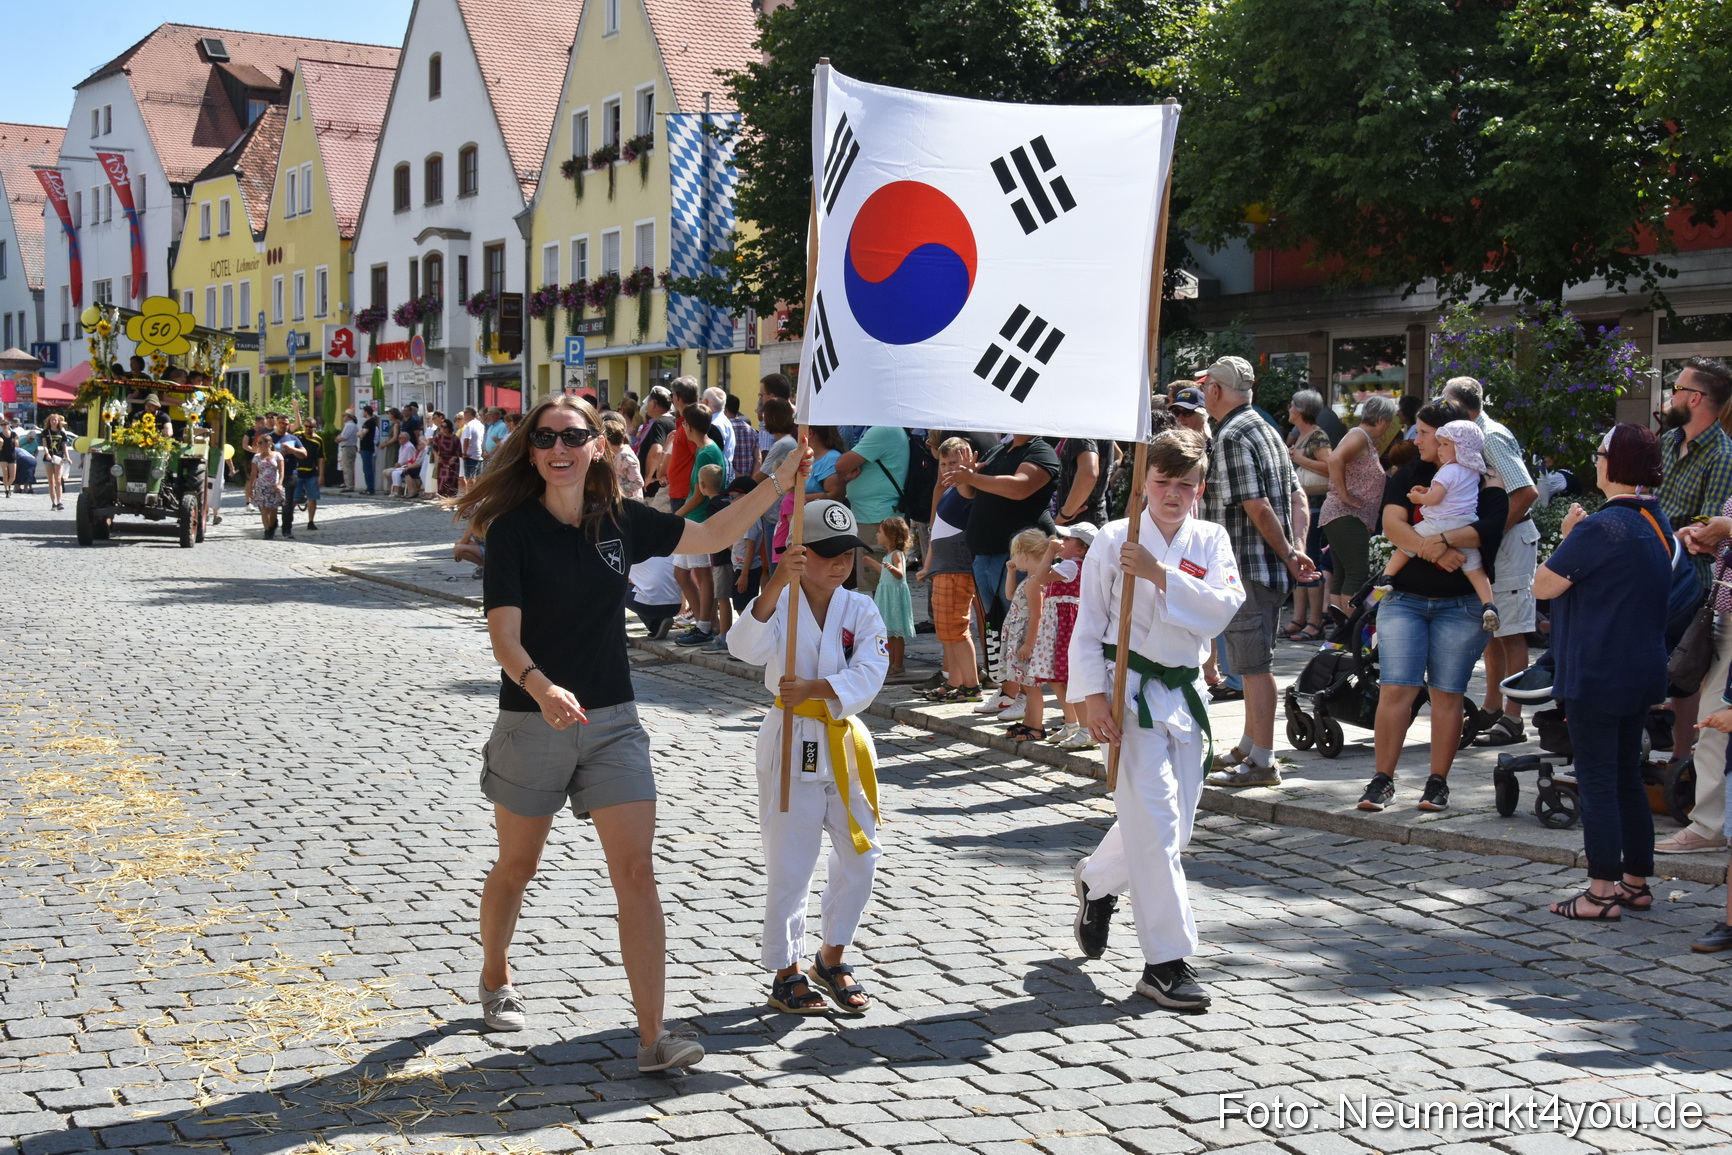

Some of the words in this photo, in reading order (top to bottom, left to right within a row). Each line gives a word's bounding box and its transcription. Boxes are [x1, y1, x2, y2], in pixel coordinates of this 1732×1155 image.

[210, 259, 231, 278] HOTEL
[236, 257, 259, 273] Lehmeier
[149, 322, 171, 336] 50
[569, 340, 580, 363] P
[806, 743, 816, 763] KWON
